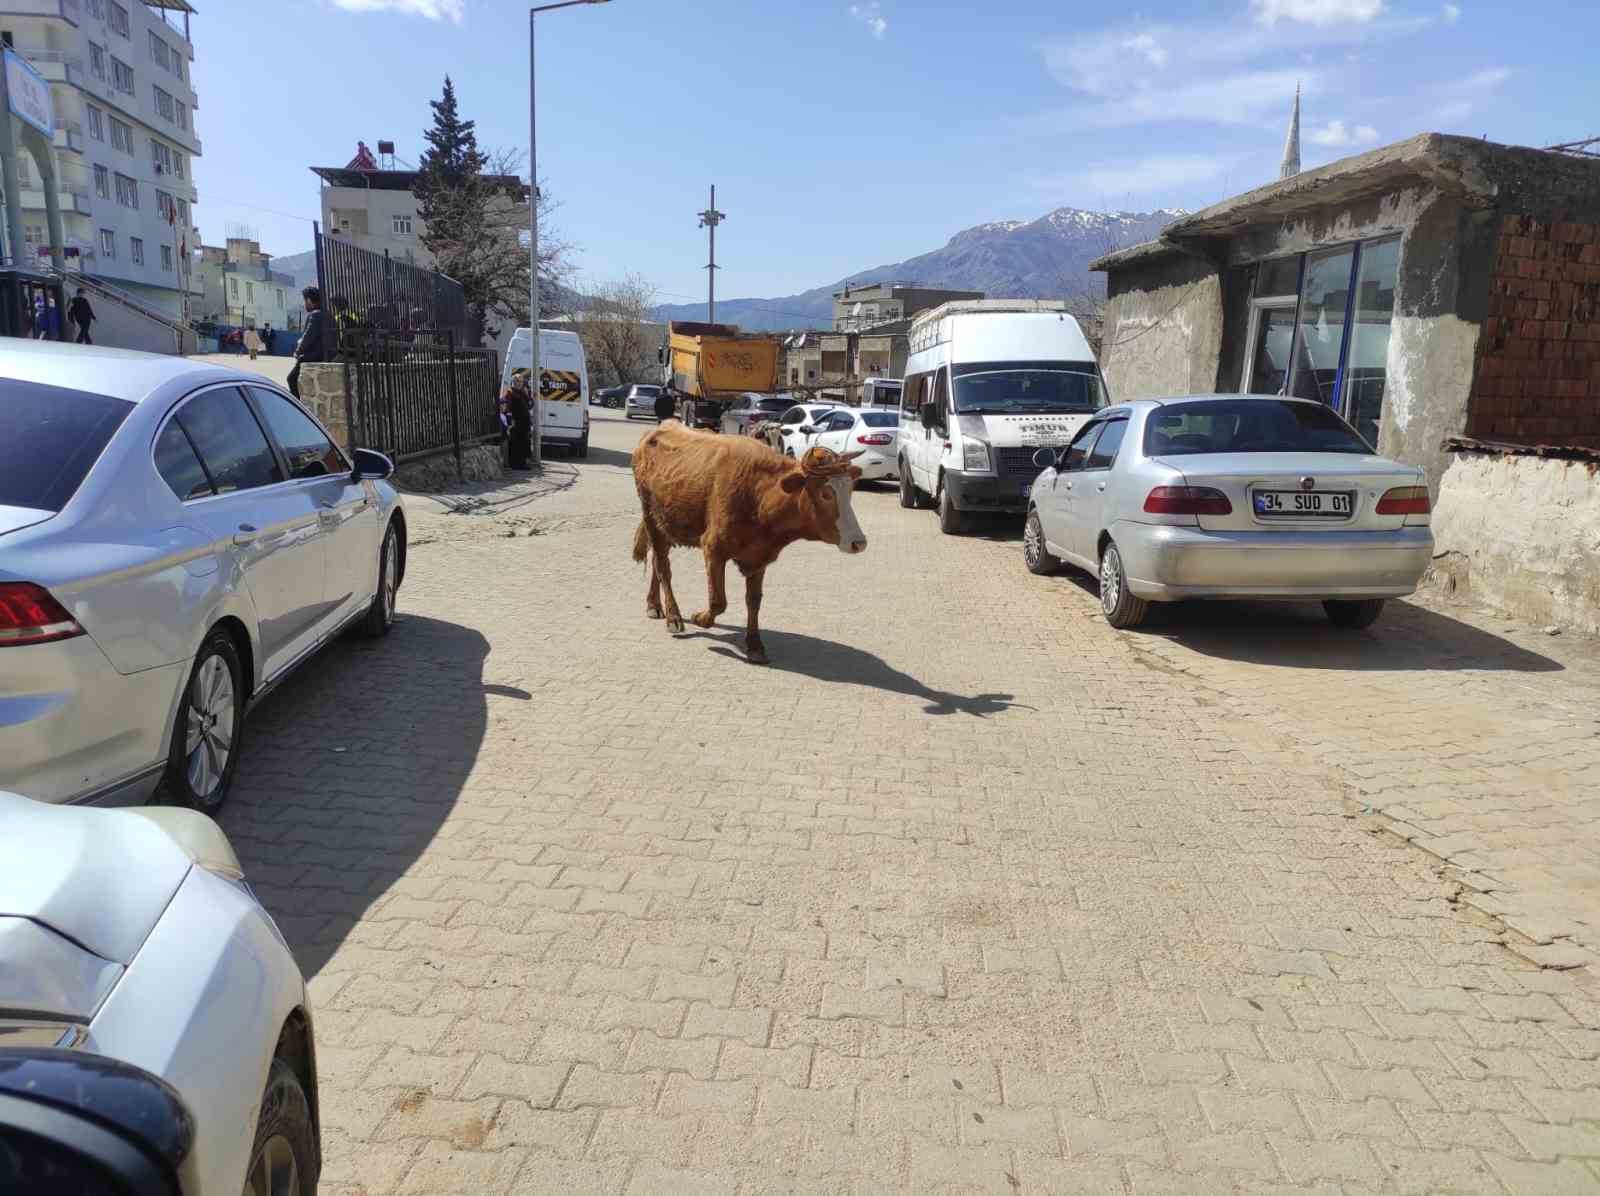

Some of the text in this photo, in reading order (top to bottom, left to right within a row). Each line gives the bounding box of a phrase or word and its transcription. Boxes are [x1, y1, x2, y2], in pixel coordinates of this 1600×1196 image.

[1265, 495, 1348, 511] 34 SUD 01
